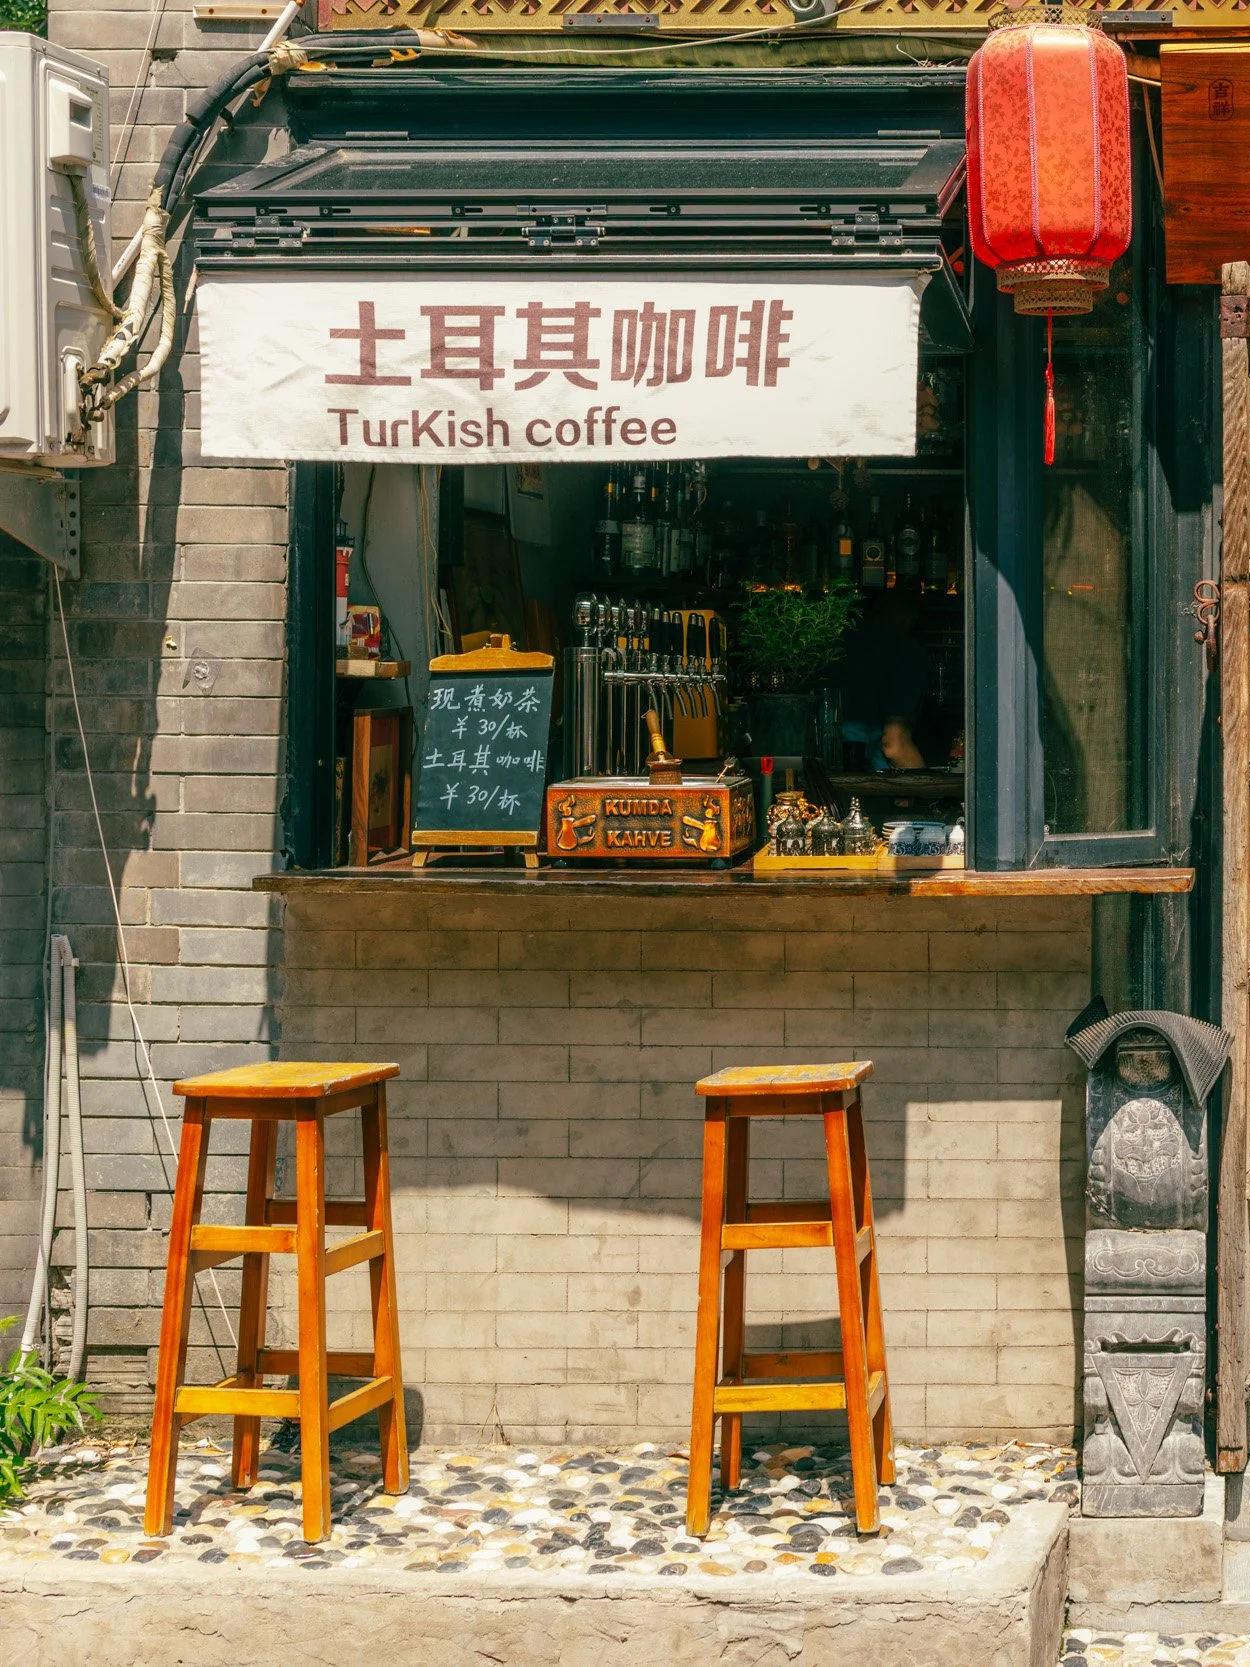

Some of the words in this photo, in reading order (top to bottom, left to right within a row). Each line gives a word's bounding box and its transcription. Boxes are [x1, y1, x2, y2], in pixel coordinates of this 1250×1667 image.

[325, 300, 794, 391] 土耳其咖啡
[327, 406, 510, 448] TurKish
[525, 405, 677, 446] coffee
[430, 684, 541, 713] 现煮奶茶
[423, 745, 545, 775] 土耳其咖啡
[605, 799, 673, 817] KUMDA
[607, 830, 671, 848] KAHVE
